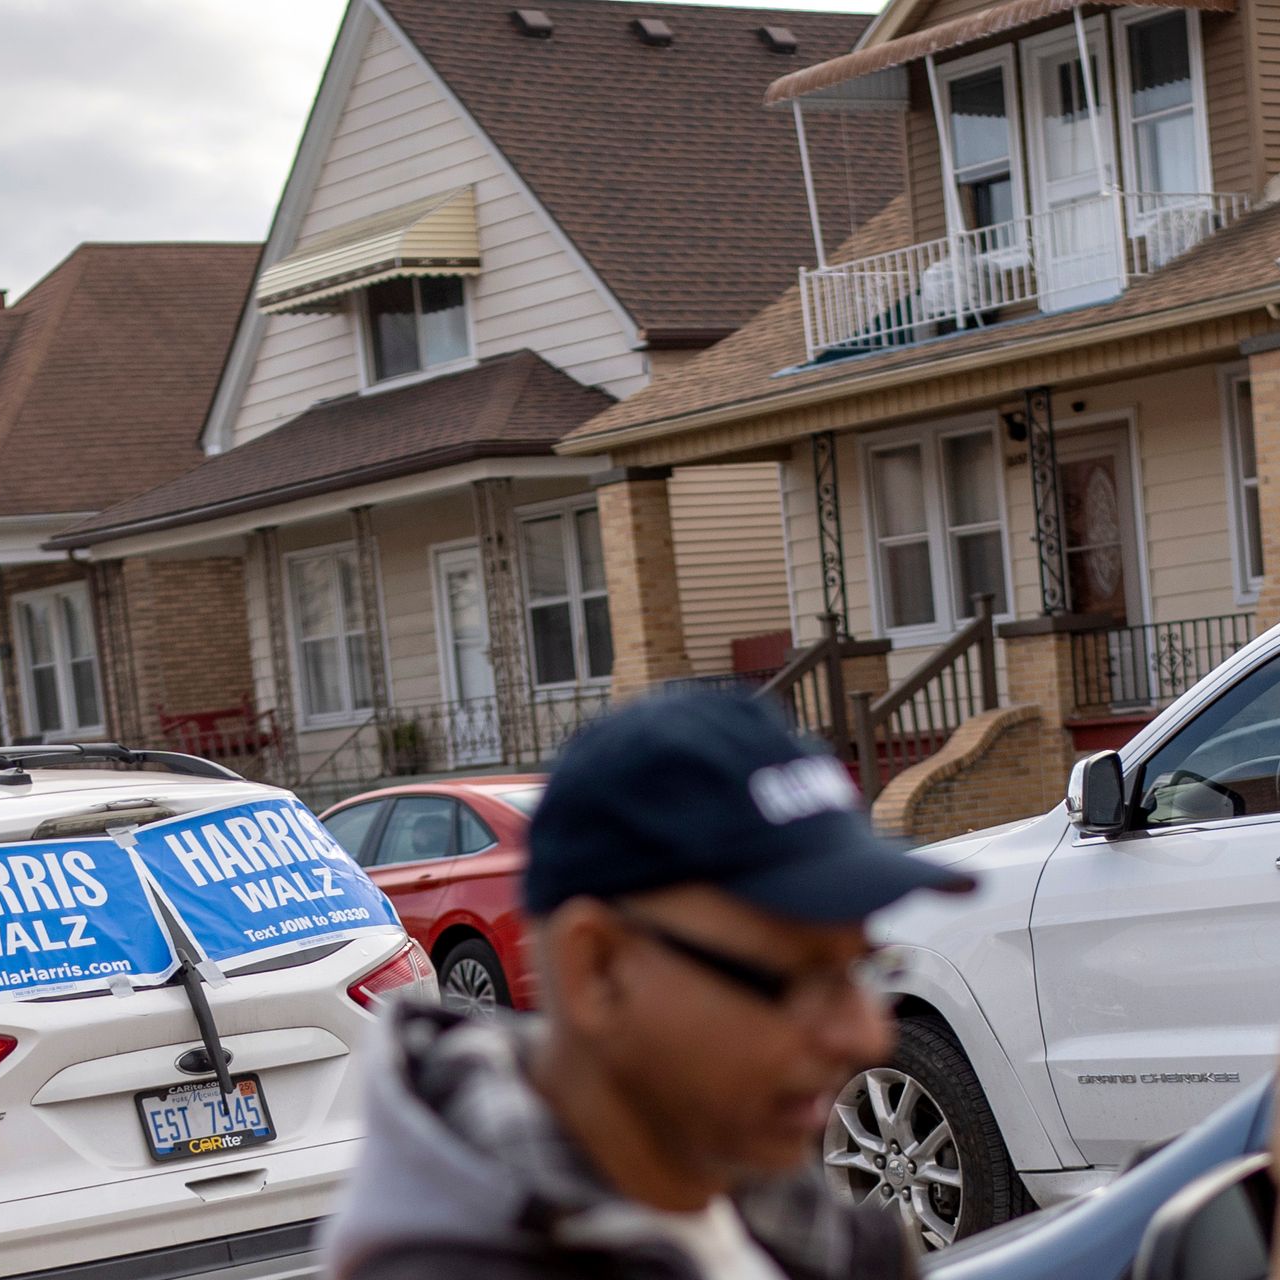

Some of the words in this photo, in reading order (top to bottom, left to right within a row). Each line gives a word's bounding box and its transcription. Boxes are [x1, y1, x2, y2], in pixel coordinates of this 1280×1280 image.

[164, 807, 348, 887] HARRIS
[230, 867, 345, 913] WALZ
[244, 924, 279, 943] Text
[279, 916, 314, 935] JOIN
[313, 914, 329, 927] to
[328, 907, 370, 924] 30330
[1077, 1074, 1137, 1085] GRAND
[1140, 1072, 1241, 1084] CHEROKEE
[150, 1105, 192, 1143] EST
[204, 1096, 262, 1134] 7945
